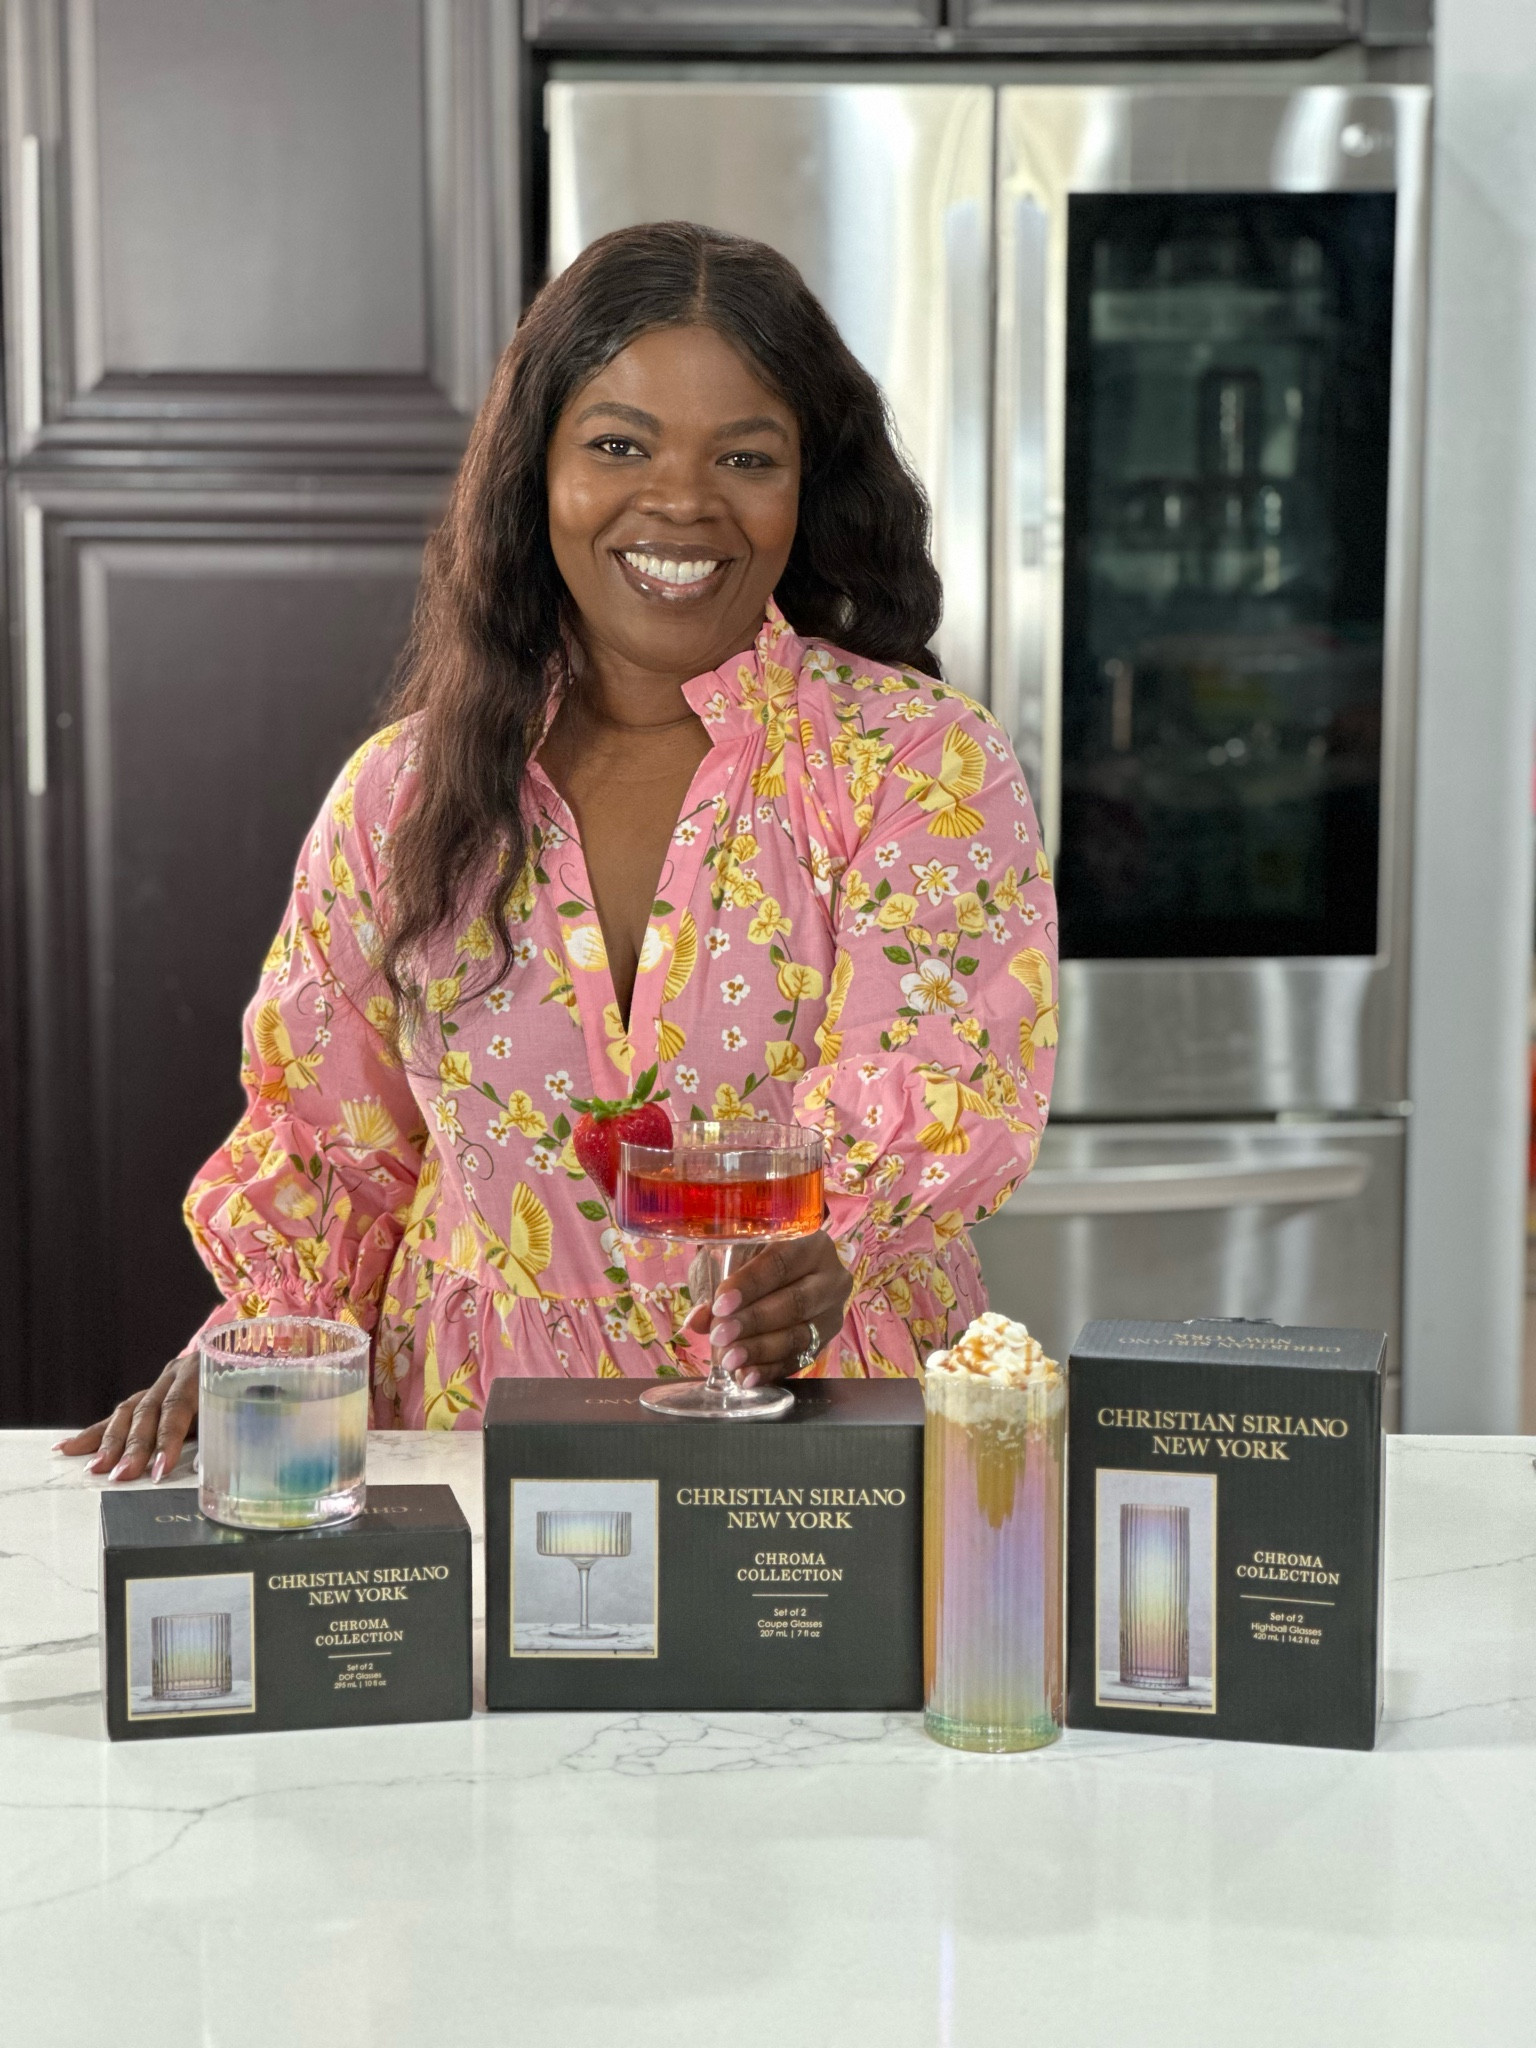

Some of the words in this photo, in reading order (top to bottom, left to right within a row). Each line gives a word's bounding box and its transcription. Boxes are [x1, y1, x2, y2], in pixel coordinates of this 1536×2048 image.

[1217, 1341, 1342, 1353] CHRISTIAN
[1097, 1408, 1236, 1433] CHRISTIAN
[1243, 1416, 1349, 1438] SIRIANO
[1152, 1436, 1211, 1456] NEW
[1217, 1439, 1290, 1461] YORK
[676, 1488, 804, 1507] CHRISTIAN
[809, 1488, 906, 1507] SIRIANO
[727, 1511, 780, 1529] NEW
[782, 1511, 853, 1529] YORK
[754, 1552, 826, 1565] CHROMA
[1254, 1551, 1323, 1568] CHROMA
[268, 1570, 370, 1590] CHRISTIAN
[373, 1565, 448, 1585] SIRIANO
[737, 1569, 843, 1581] COLLECTION
[1236, 1565, 1340, 1585] COLLECTION
[309, 1589, 352, 1605] NEW
[355, 1587, 408, 1604] YORK
[773, 1608, 788, 1617] Set
[789, 1608, 799, 1617] of
[800, 1608, 807, 1617] 2
[1270, 1612, 1285, 1621] Set
[1286, 1614, 1296, 1622] of
[1297, 1615, 1304, 1624] 2
[329, 1618, 389, 1632] CHROMA
[757, 1619, 789, 1630] Coupe
[790, 1619, 823, 1628] Glasses
[1251, 1622, 1288, 1633] Highball
[1289, 1625, 1322, 1636] Glasses
[315, 1630, 404, 1647] COLLECTION
[760, 1629, 775, 1638] 207
[775, 1629, 788, 1638] mL
[797, 1629, 803, 1638] 7
[1253, 1632, 1267, 1641] 420
[1267, 1634, 1279, 1642] mL
[1288, 1635, 1303, 1644] 14.2
[347, 1664, 359, 1672] Set
[360, 1663, 368, 1671] of
[368, 1662, 374, 1670] 2
[338, 1673, 355, 1681] DOF
[355, 1672, 382, 1680] Glasses
